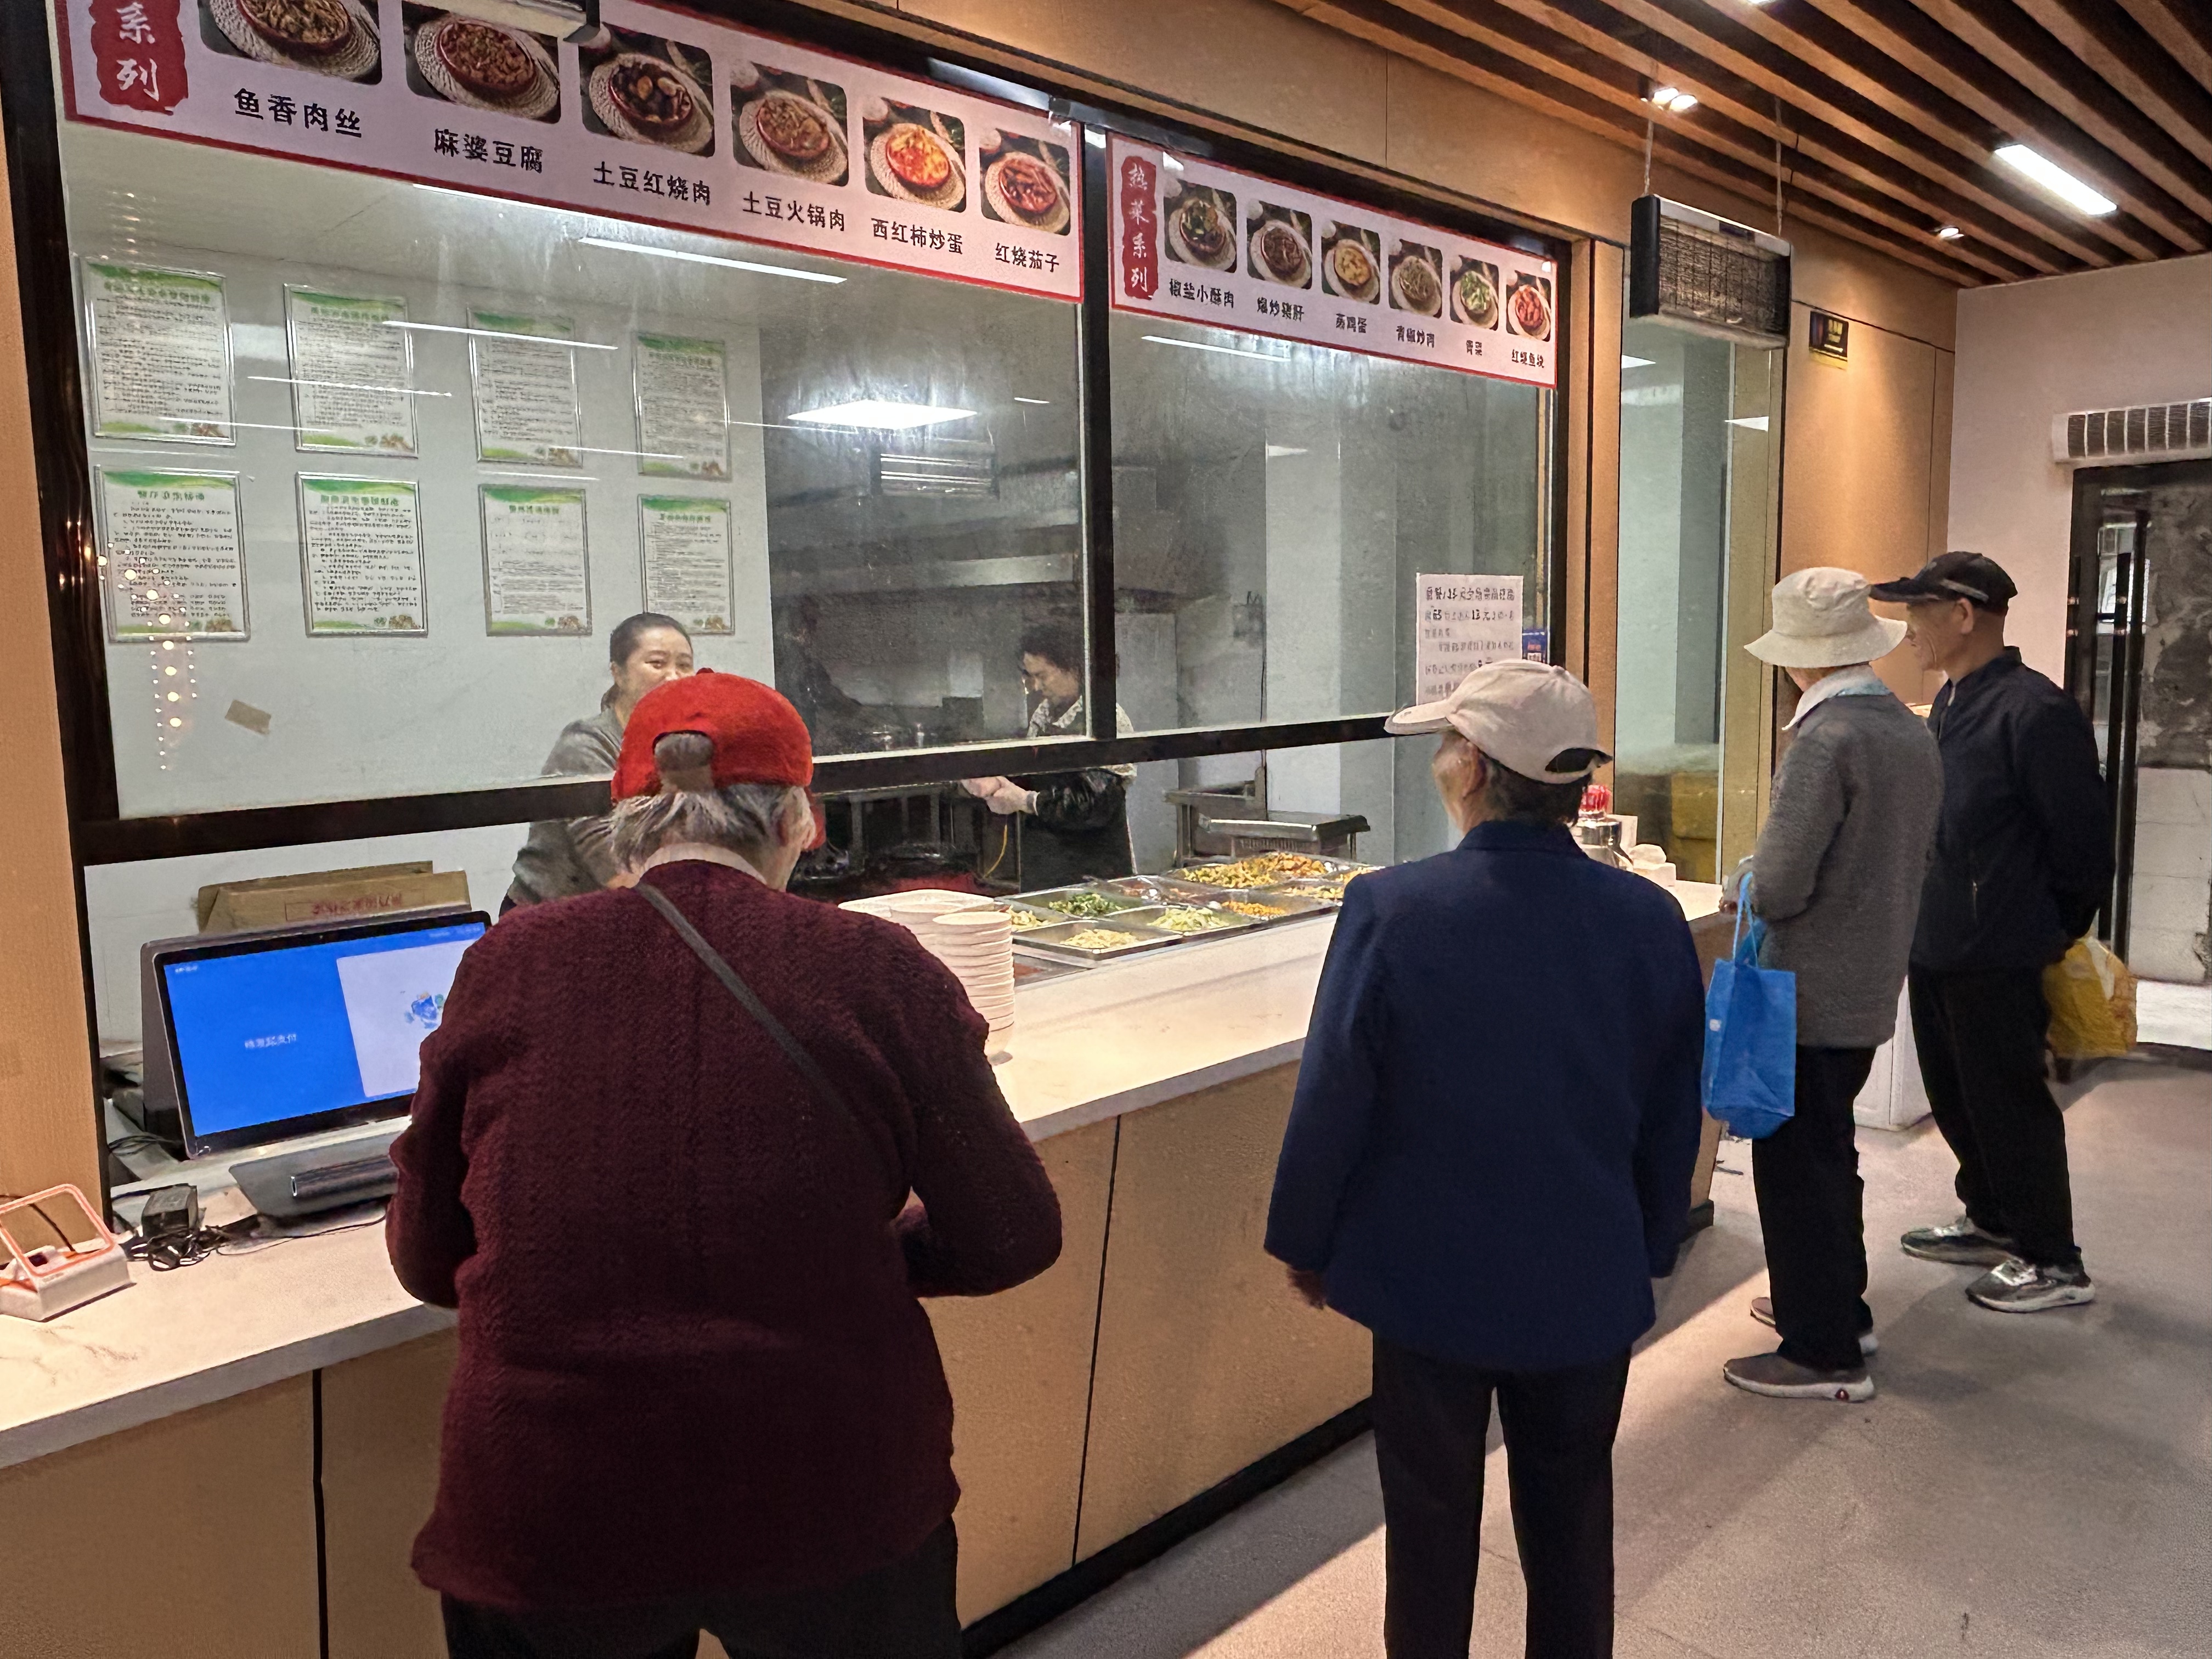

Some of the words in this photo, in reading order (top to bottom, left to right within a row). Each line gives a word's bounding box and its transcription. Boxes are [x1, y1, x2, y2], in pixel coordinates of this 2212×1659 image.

[117, 2, 159, 101] 系列
[234, 88, 362, 138] 鱼香肉丝
[434, 128, 543, 173] 麻婆豆腐
[593, 161, 710, 206] 土豆红烧肉
[742, 191, 844, 231] 土豆火锅肉
[1128, 162, 1150, 292] 热菜系列
[871, 218, 963, 255] 西红柿炒蛋
[995, 242, 1059, 273] 红烧茄子
